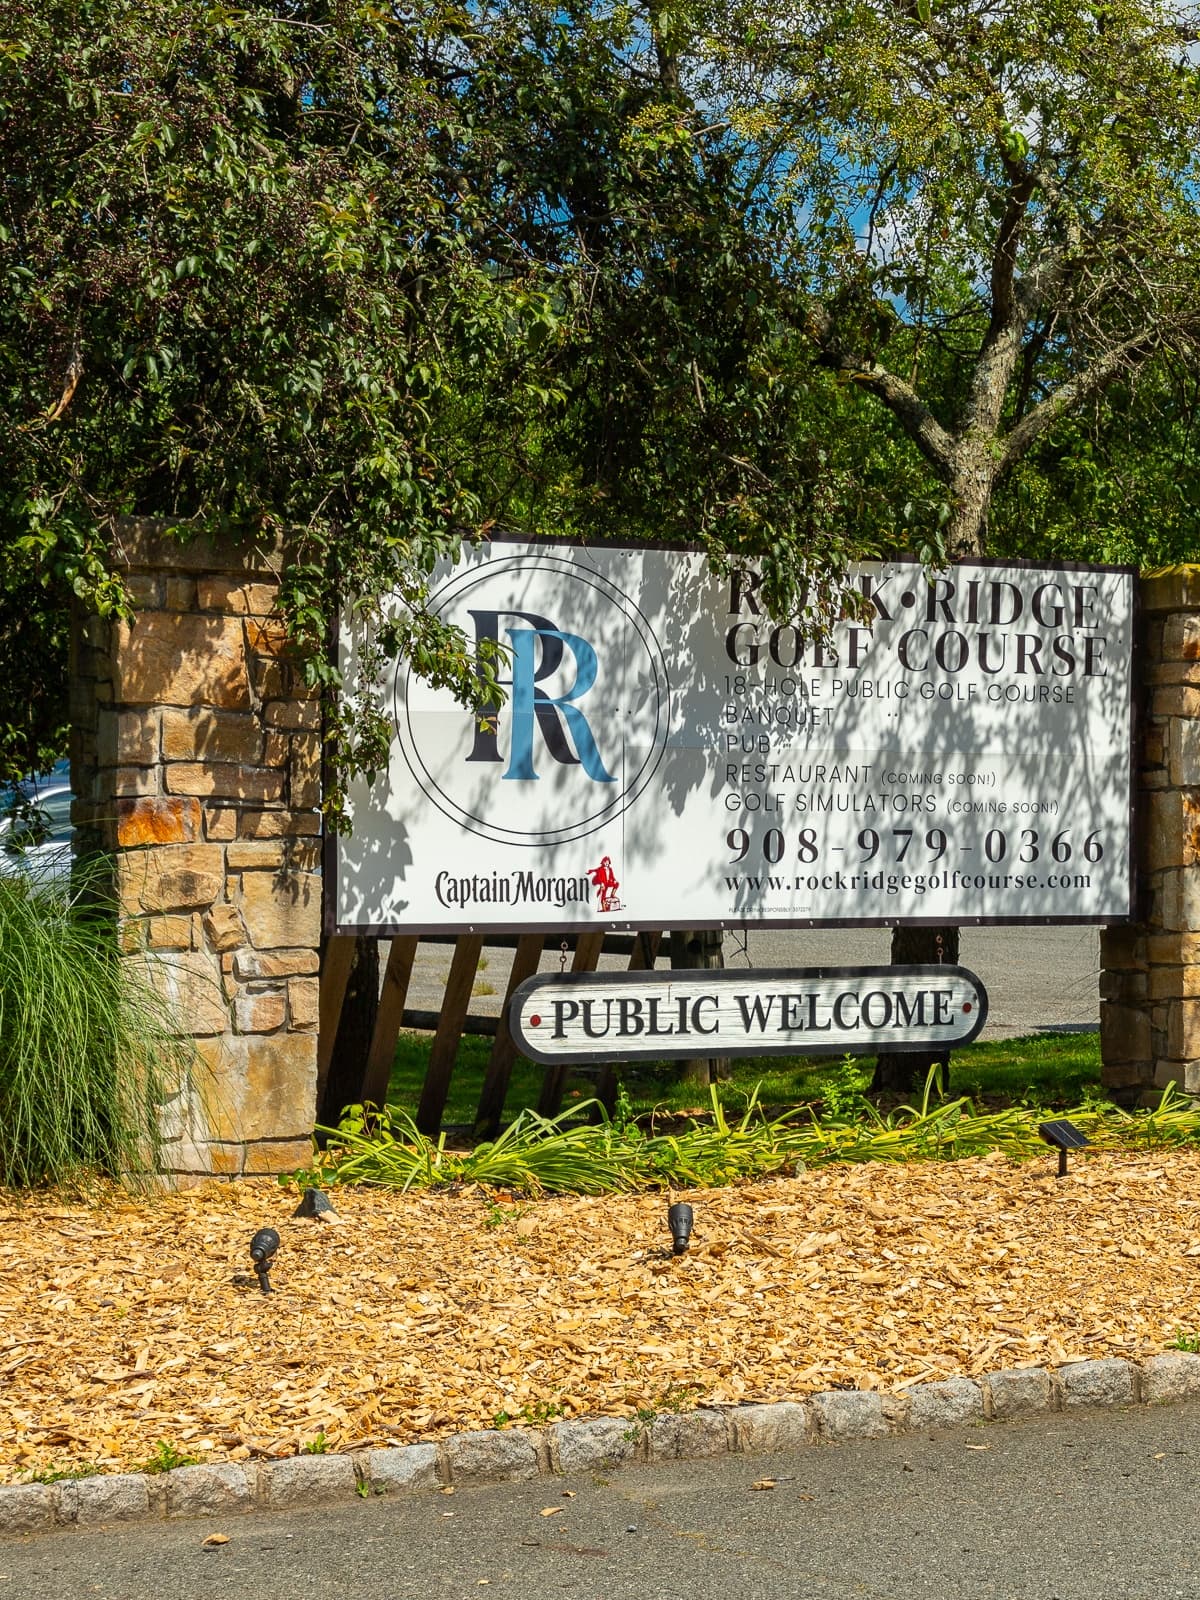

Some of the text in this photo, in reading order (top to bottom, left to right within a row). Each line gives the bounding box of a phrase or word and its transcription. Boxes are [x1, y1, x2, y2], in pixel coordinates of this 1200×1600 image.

[726, 622, 1108, 677] GOLF COURSE
[724, 675, 1074, 704] 18-HOLE PUBLIC GOLF COURSE
[726, 705, 834, 728] BANQUET
[727, 735, 770, 753] PUB
[726, 764, 996, 787] RESTAURANT (COMING SOON!)
[725, 793, 1059, 815] GOLF SIMULATORS (COMING SOON!)
[726, 828, 1104, 863] 908-979-0366
[434, 870, 590, 909] Captain Morgan
[725, 871, 1092, 895] www.rockridgegolfcourse.com
[550, 990, 955, 1039] PUBLIC WELCOME
